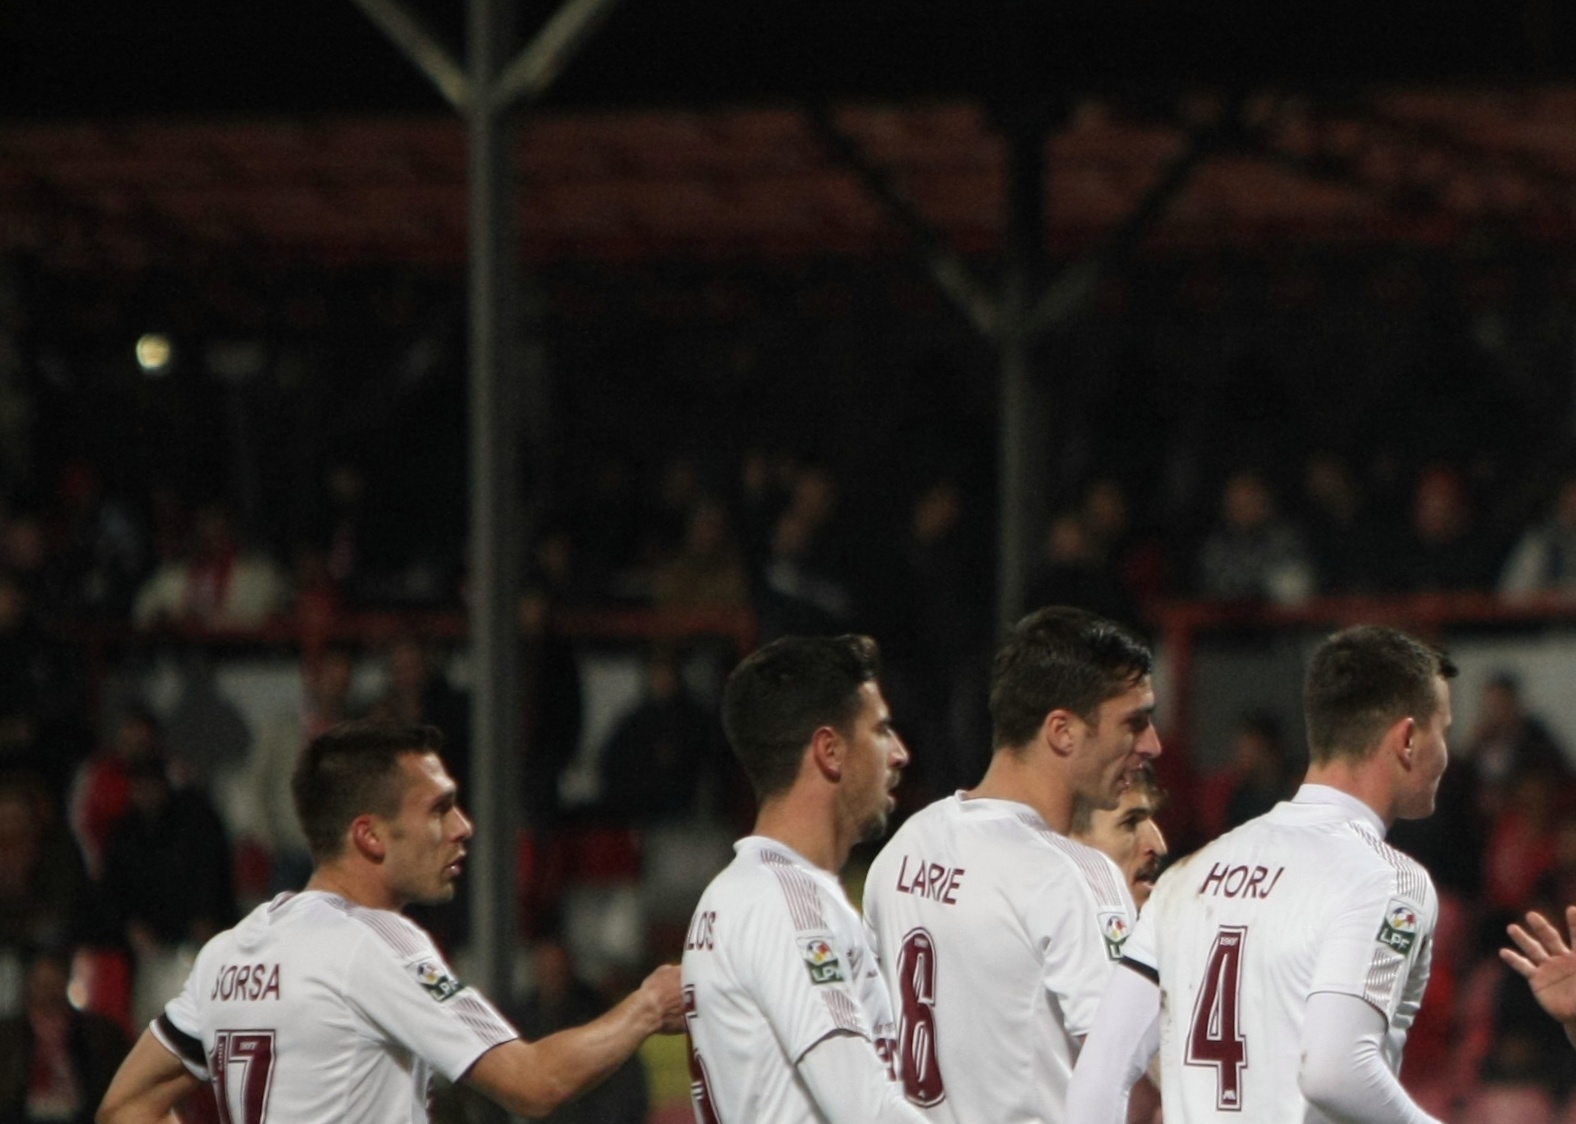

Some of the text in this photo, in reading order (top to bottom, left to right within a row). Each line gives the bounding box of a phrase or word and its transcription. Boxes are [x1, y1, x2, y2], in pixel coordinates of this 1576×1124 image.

[897, 855, 965, 905] LARIE
[1200, 862, 1285, 899] HORJ
[687, 911, 716, 950] LOS
[898, 926, 946, 1109] 6
[1184, 924, 1248, 1112] 4
